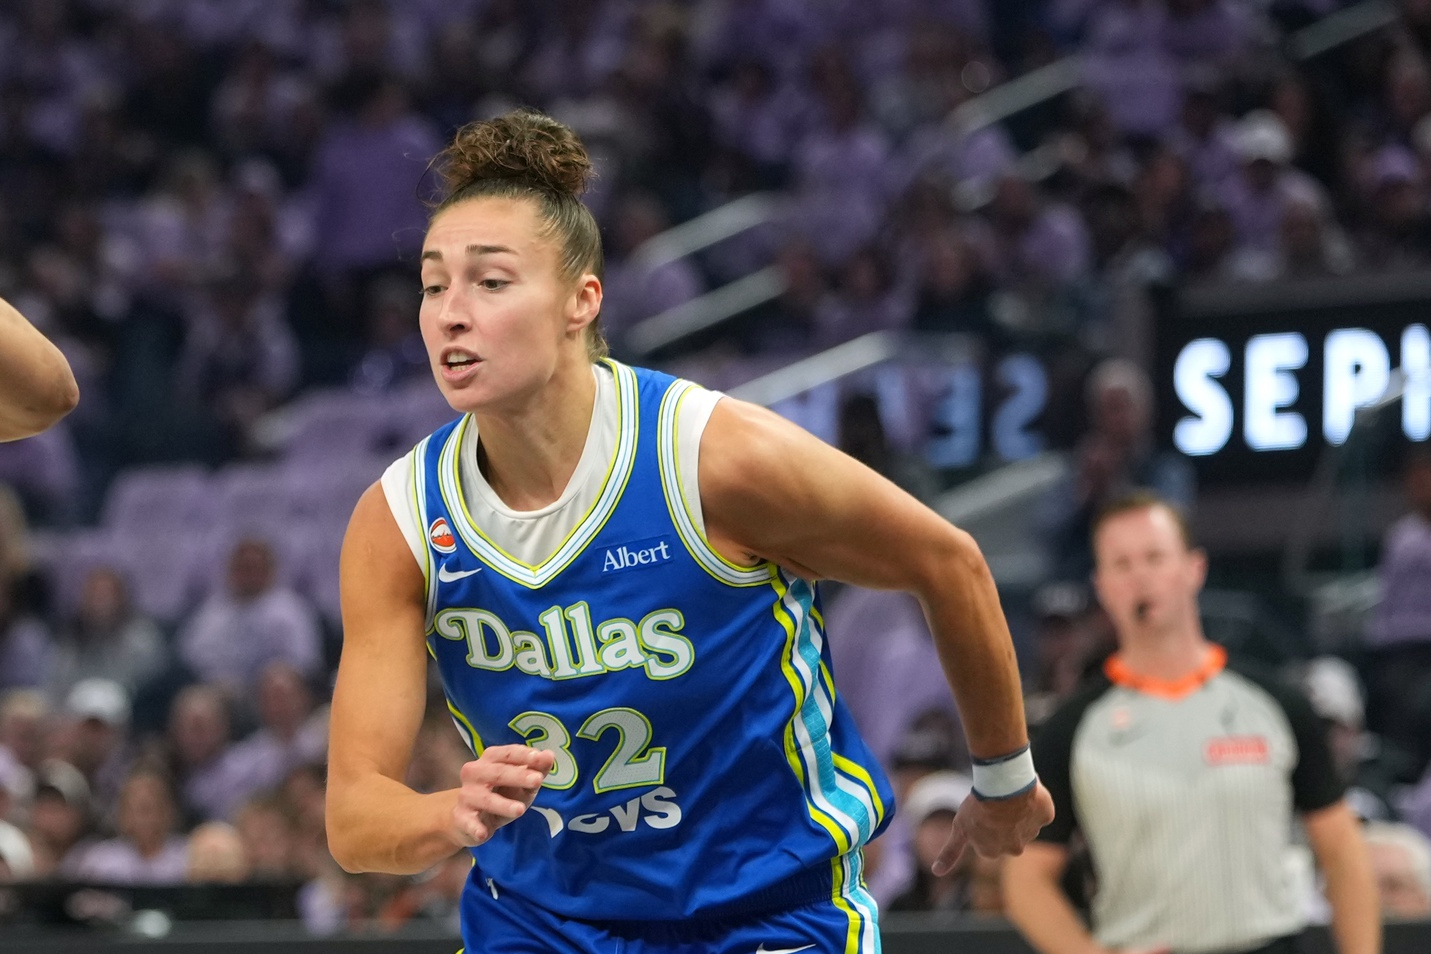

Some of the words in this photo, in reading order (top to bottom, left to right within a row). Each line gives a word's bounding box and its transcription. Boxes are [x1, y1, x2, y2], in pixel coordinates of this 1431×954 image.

[602, 541, 670, 572] Albert
[434, 600, 695, 681] Dallas
[508, 707, 666, 794] 32
